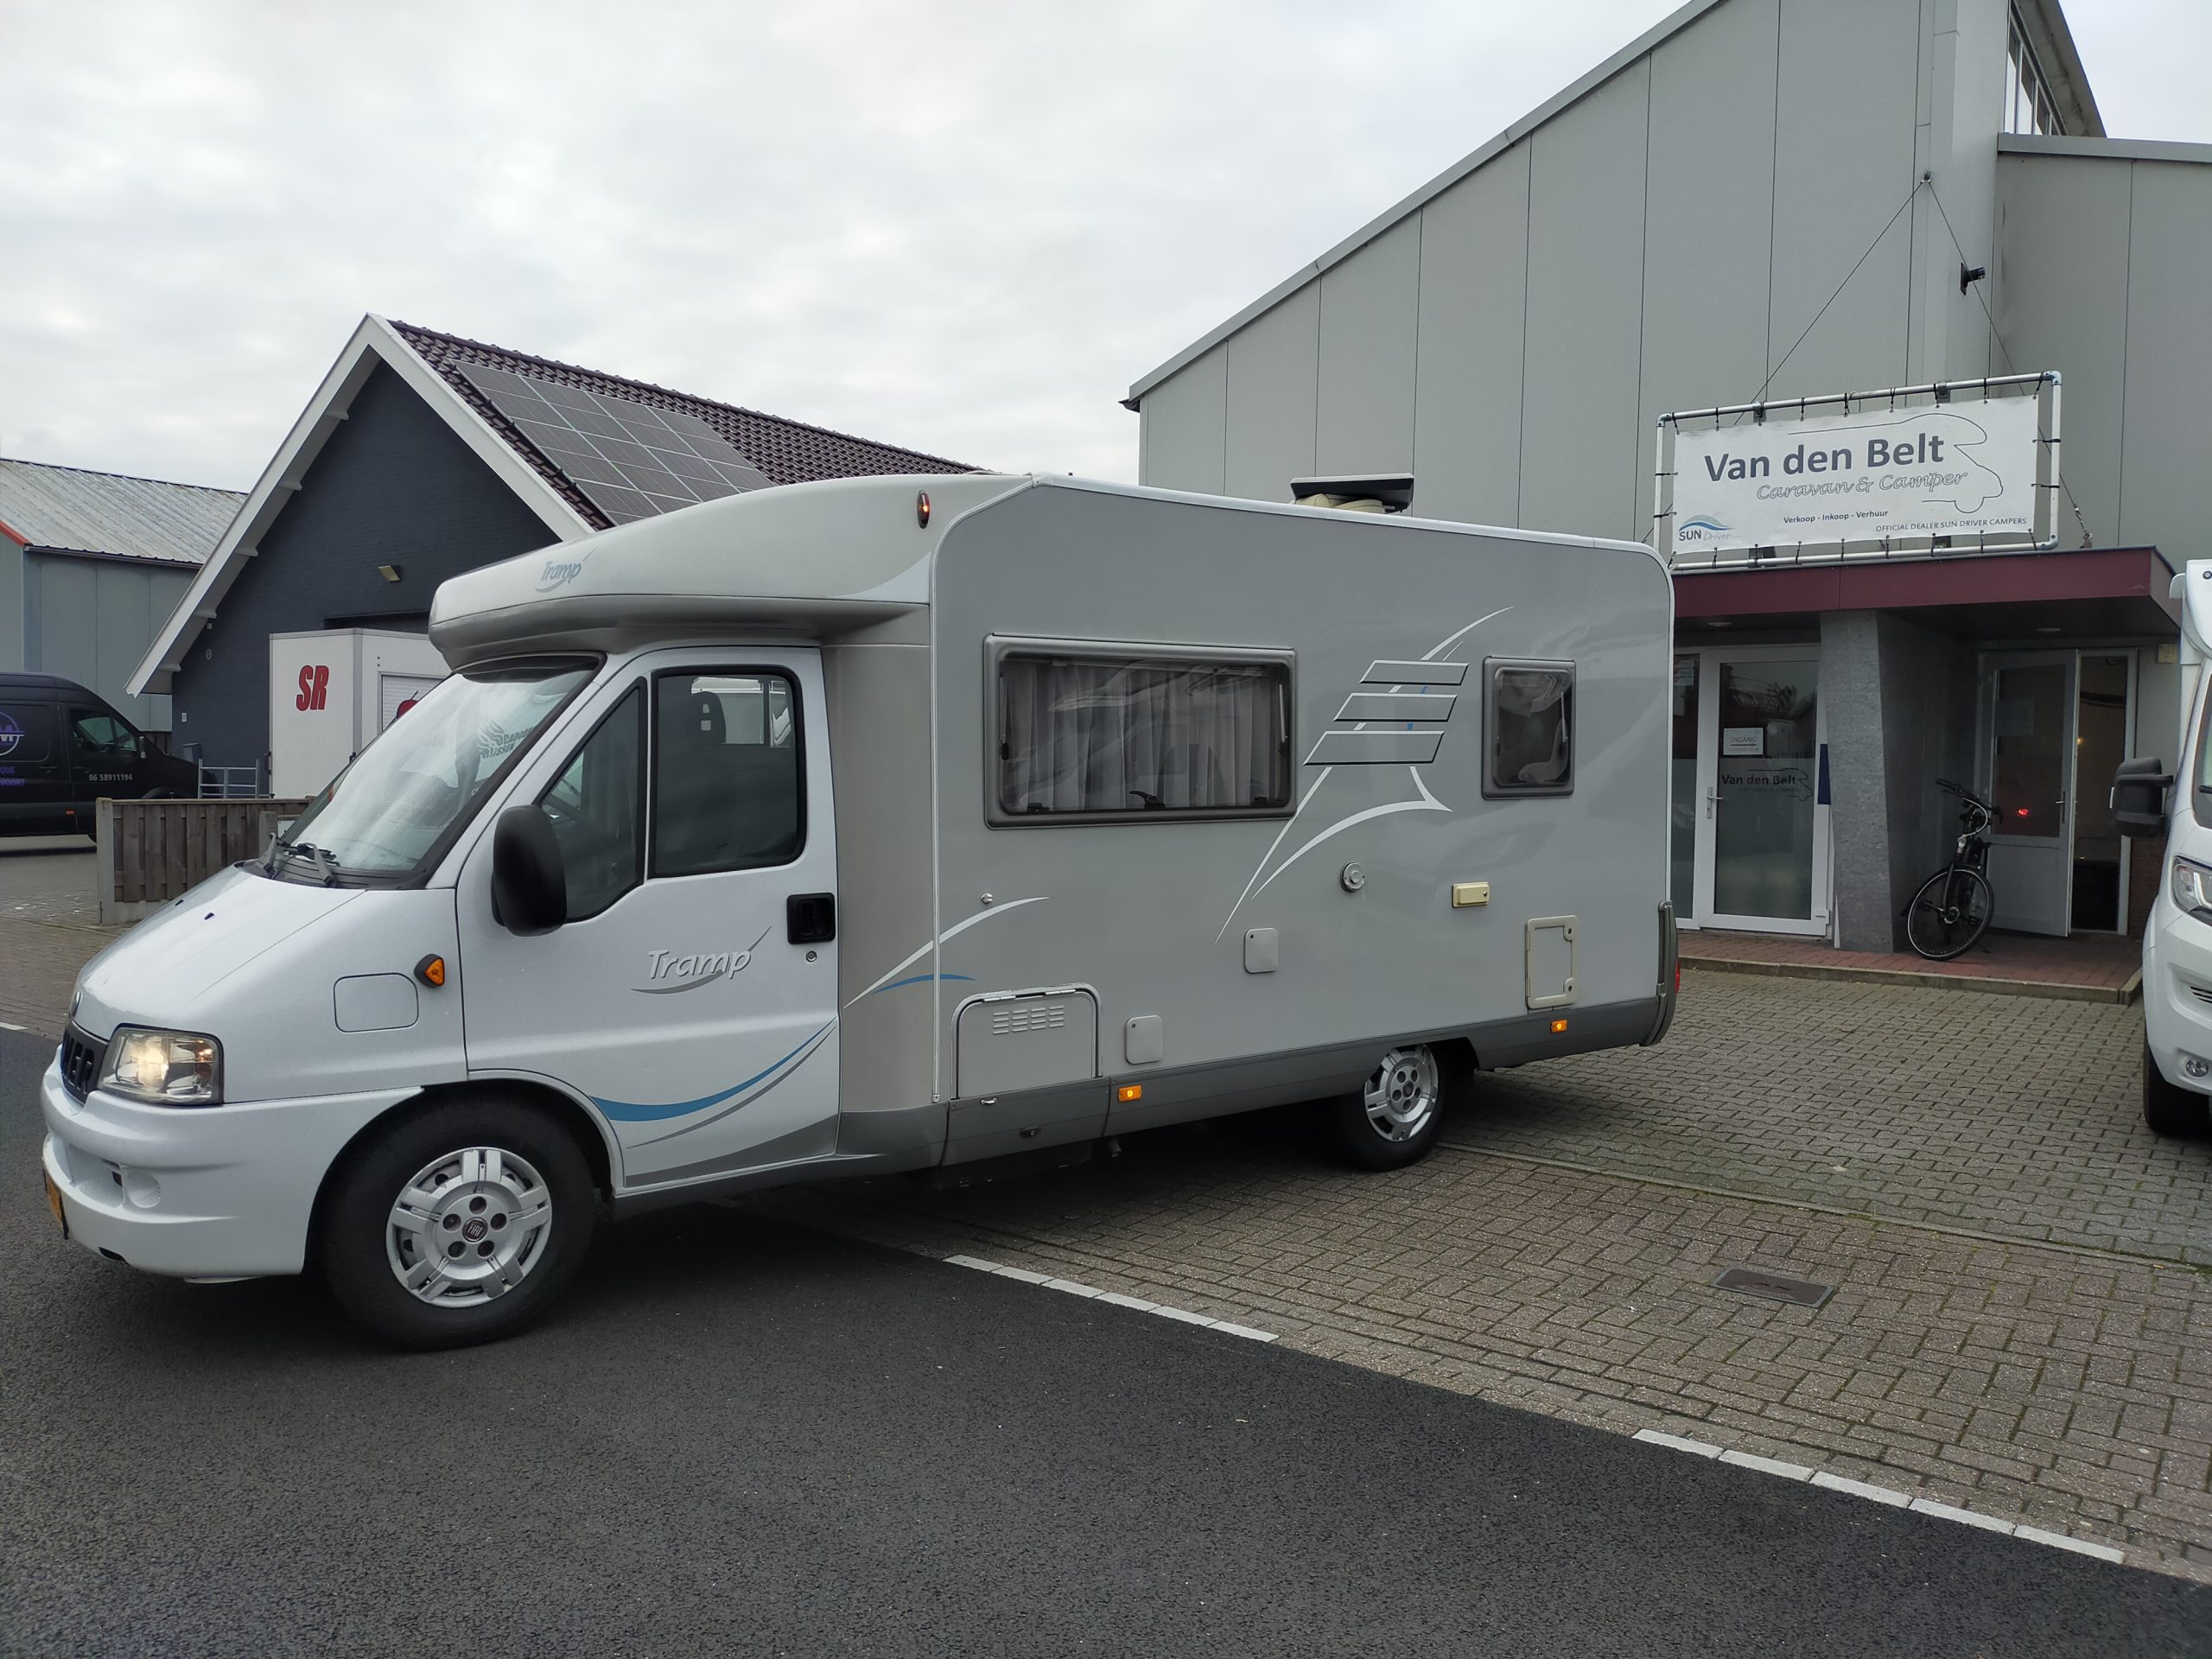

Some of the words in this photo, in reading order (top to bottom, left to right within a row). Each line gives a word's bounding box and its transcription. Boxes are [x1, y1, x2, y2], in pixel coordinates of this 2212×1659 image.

[1704, 454, 1770, 481] Van
[1783, 444, 1853, 474] den
[1867, 432, 1944, 467] Belt
[1756, 480, 1854, 500] Caravan
[1855, 476, 1873, 493] &
[1878, 471, 1968, 492] Camper
[1783, 515, 1815, 524] Verkoop
[1822, 512, 1849, 521] Inkoop
[1856, 510, 1889, 518] Verhuur
[1875, 524, 1909, 532] OFFICIAL
[1910, 522, 1939, 531] DEALER
[1960, 518, 1987, 527] DRIVER
[1679, 530, 1701, 541] SUN
[541, 561, 582, 584] Tramp
[296, 664, 329, 712] SR
[1722, 774, 1743, 785] Van
[1747, 774, 1769, 785] den
[1773, 774, 1796, 785] Belt
[648, 949, 752, 980] Tramp
[467, 1223, 483, 1237] FIAT
